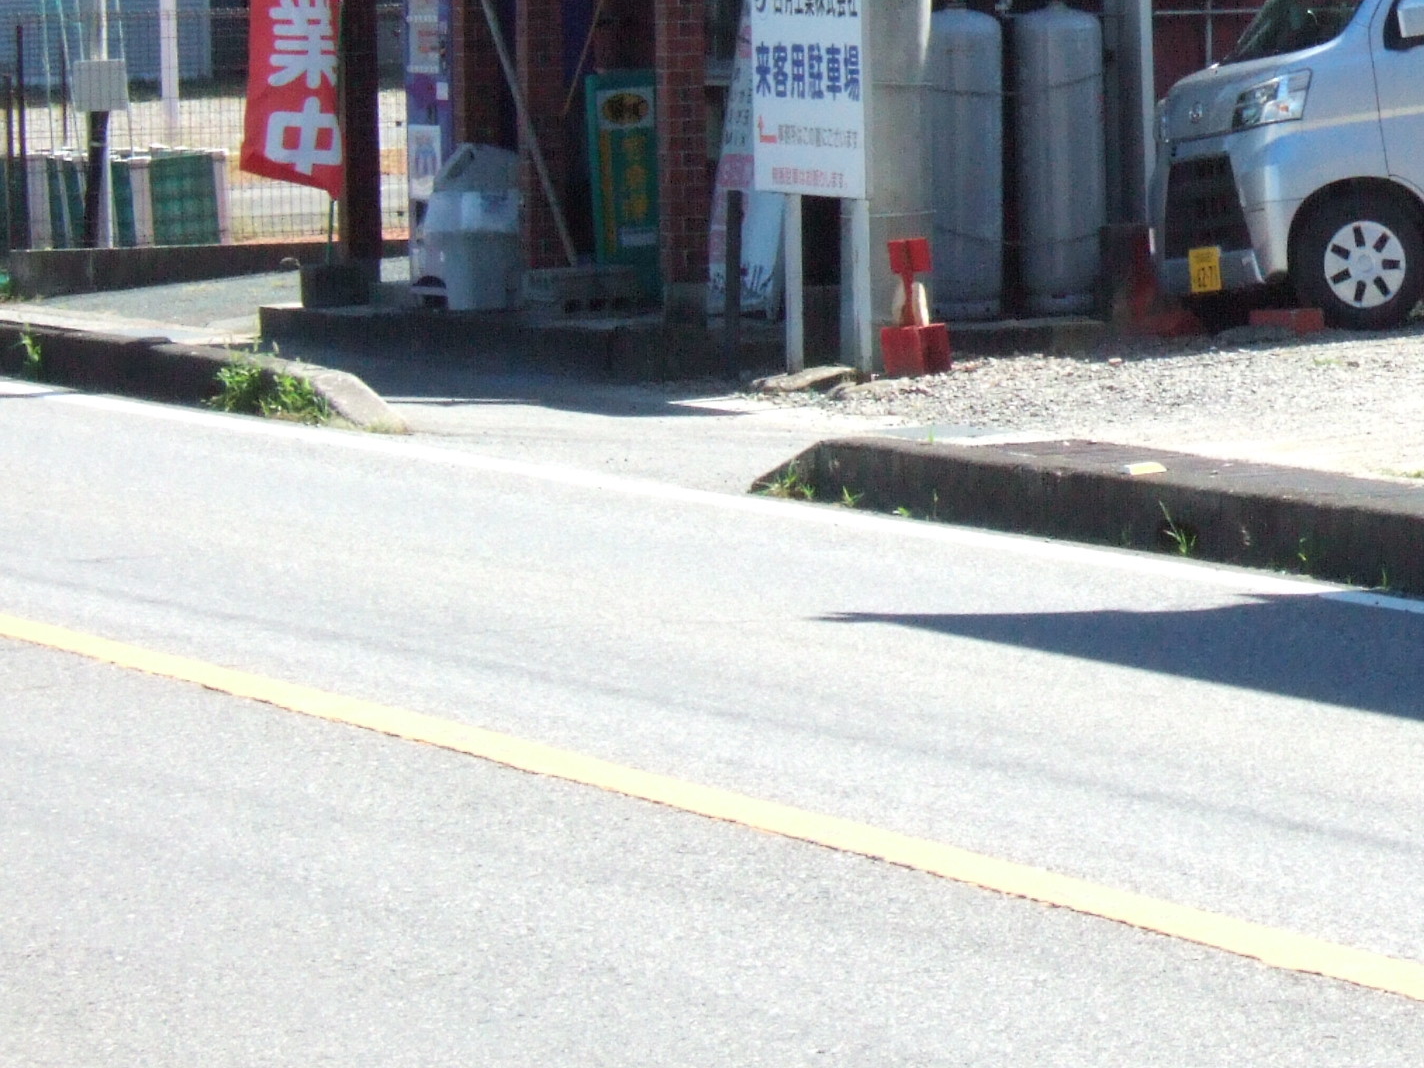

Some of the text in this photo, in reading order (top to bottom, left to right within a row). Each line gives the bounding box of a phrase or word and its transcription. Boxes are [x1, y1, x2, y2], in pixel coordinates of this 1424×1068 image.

[756, 40, 860, 102] 来客用駐車場
